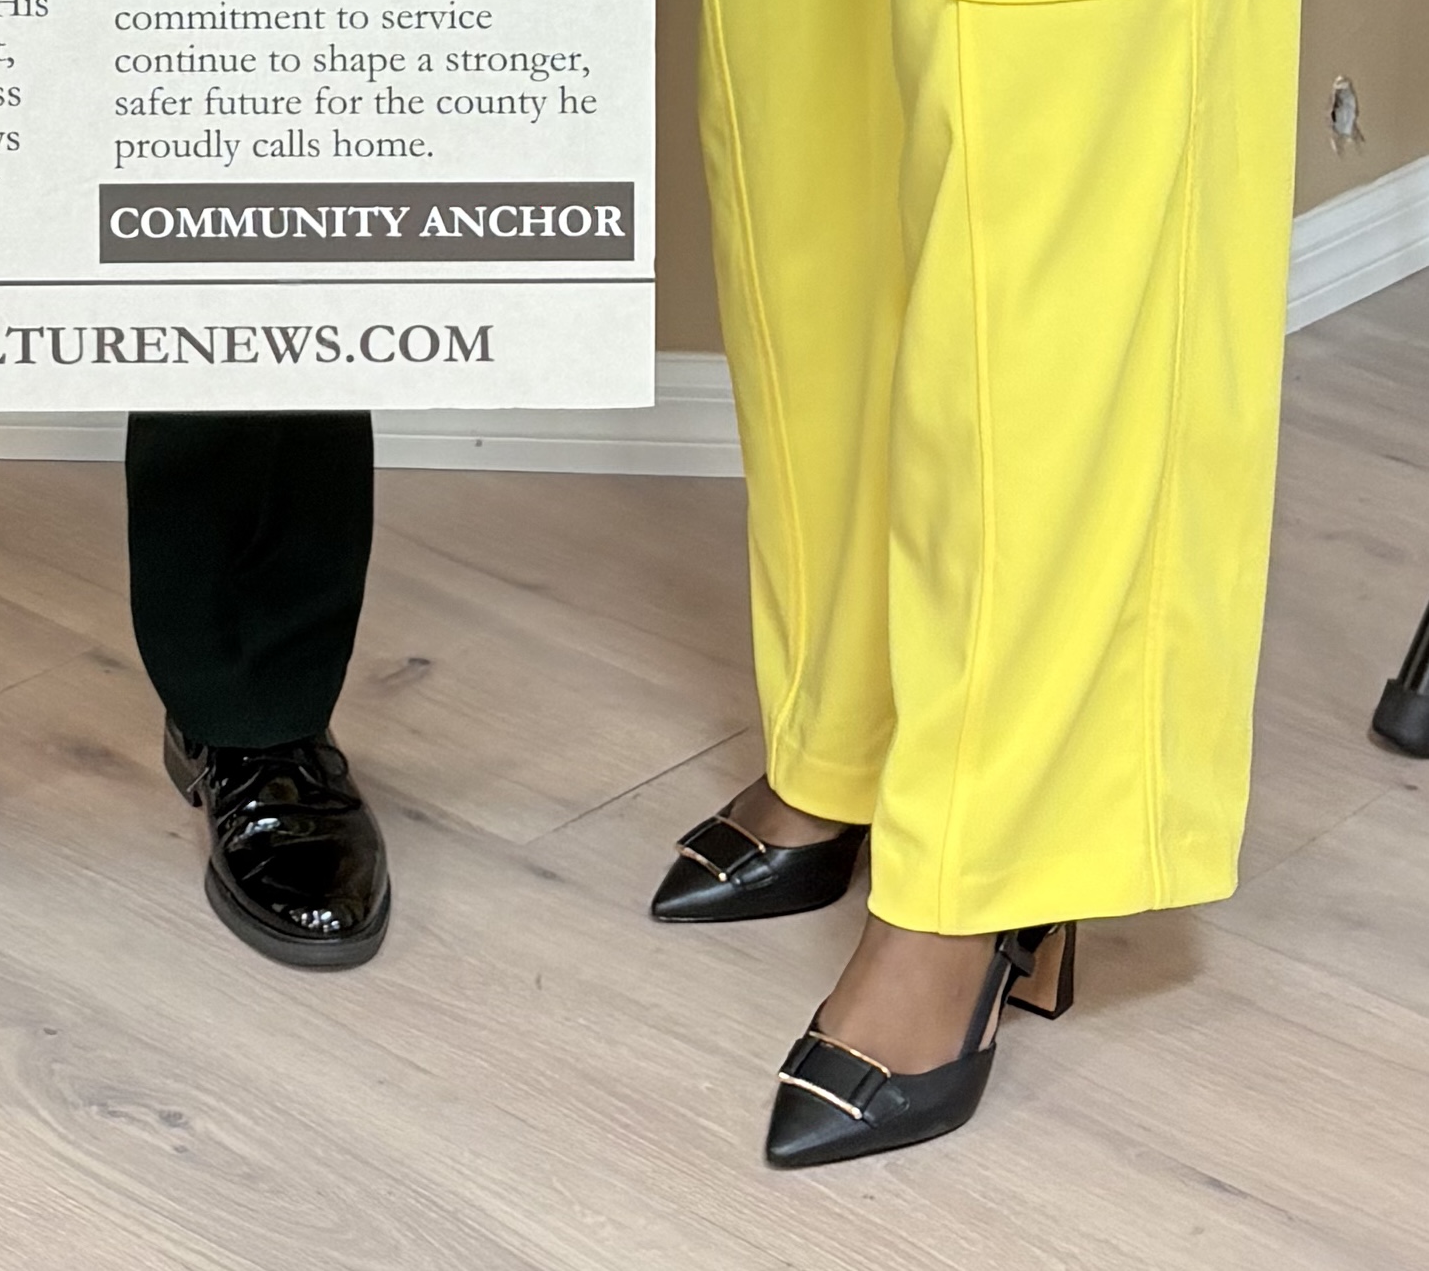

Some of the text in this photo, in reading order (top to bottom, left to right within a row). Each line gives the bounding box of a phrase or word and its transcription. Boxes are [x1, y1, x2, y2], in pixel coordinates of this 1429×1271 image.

[115, 1, 491, 30] commitment to service
[115, 44, 589, 82] continue to shape a stronger,
[115, 129, 432, 168] proudly calls home.
[111, 206, 625, 238] COMMUNITY ANCHOR
